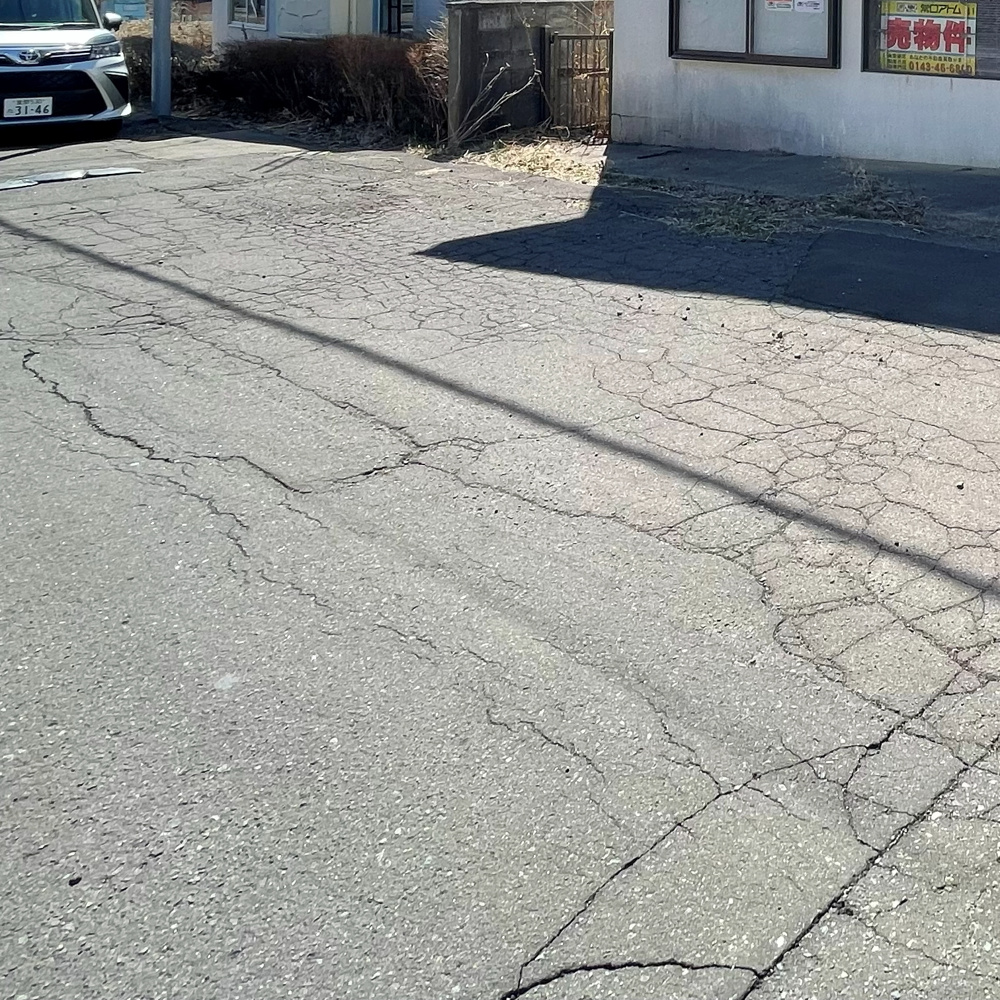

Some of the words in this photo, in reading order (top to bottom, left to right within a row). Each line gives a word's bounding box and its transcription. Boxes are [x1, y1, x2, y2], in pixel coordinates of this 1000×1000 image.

[884, 18, 971, 53] 売物件
[15, 105, 49, 115] 31-46
